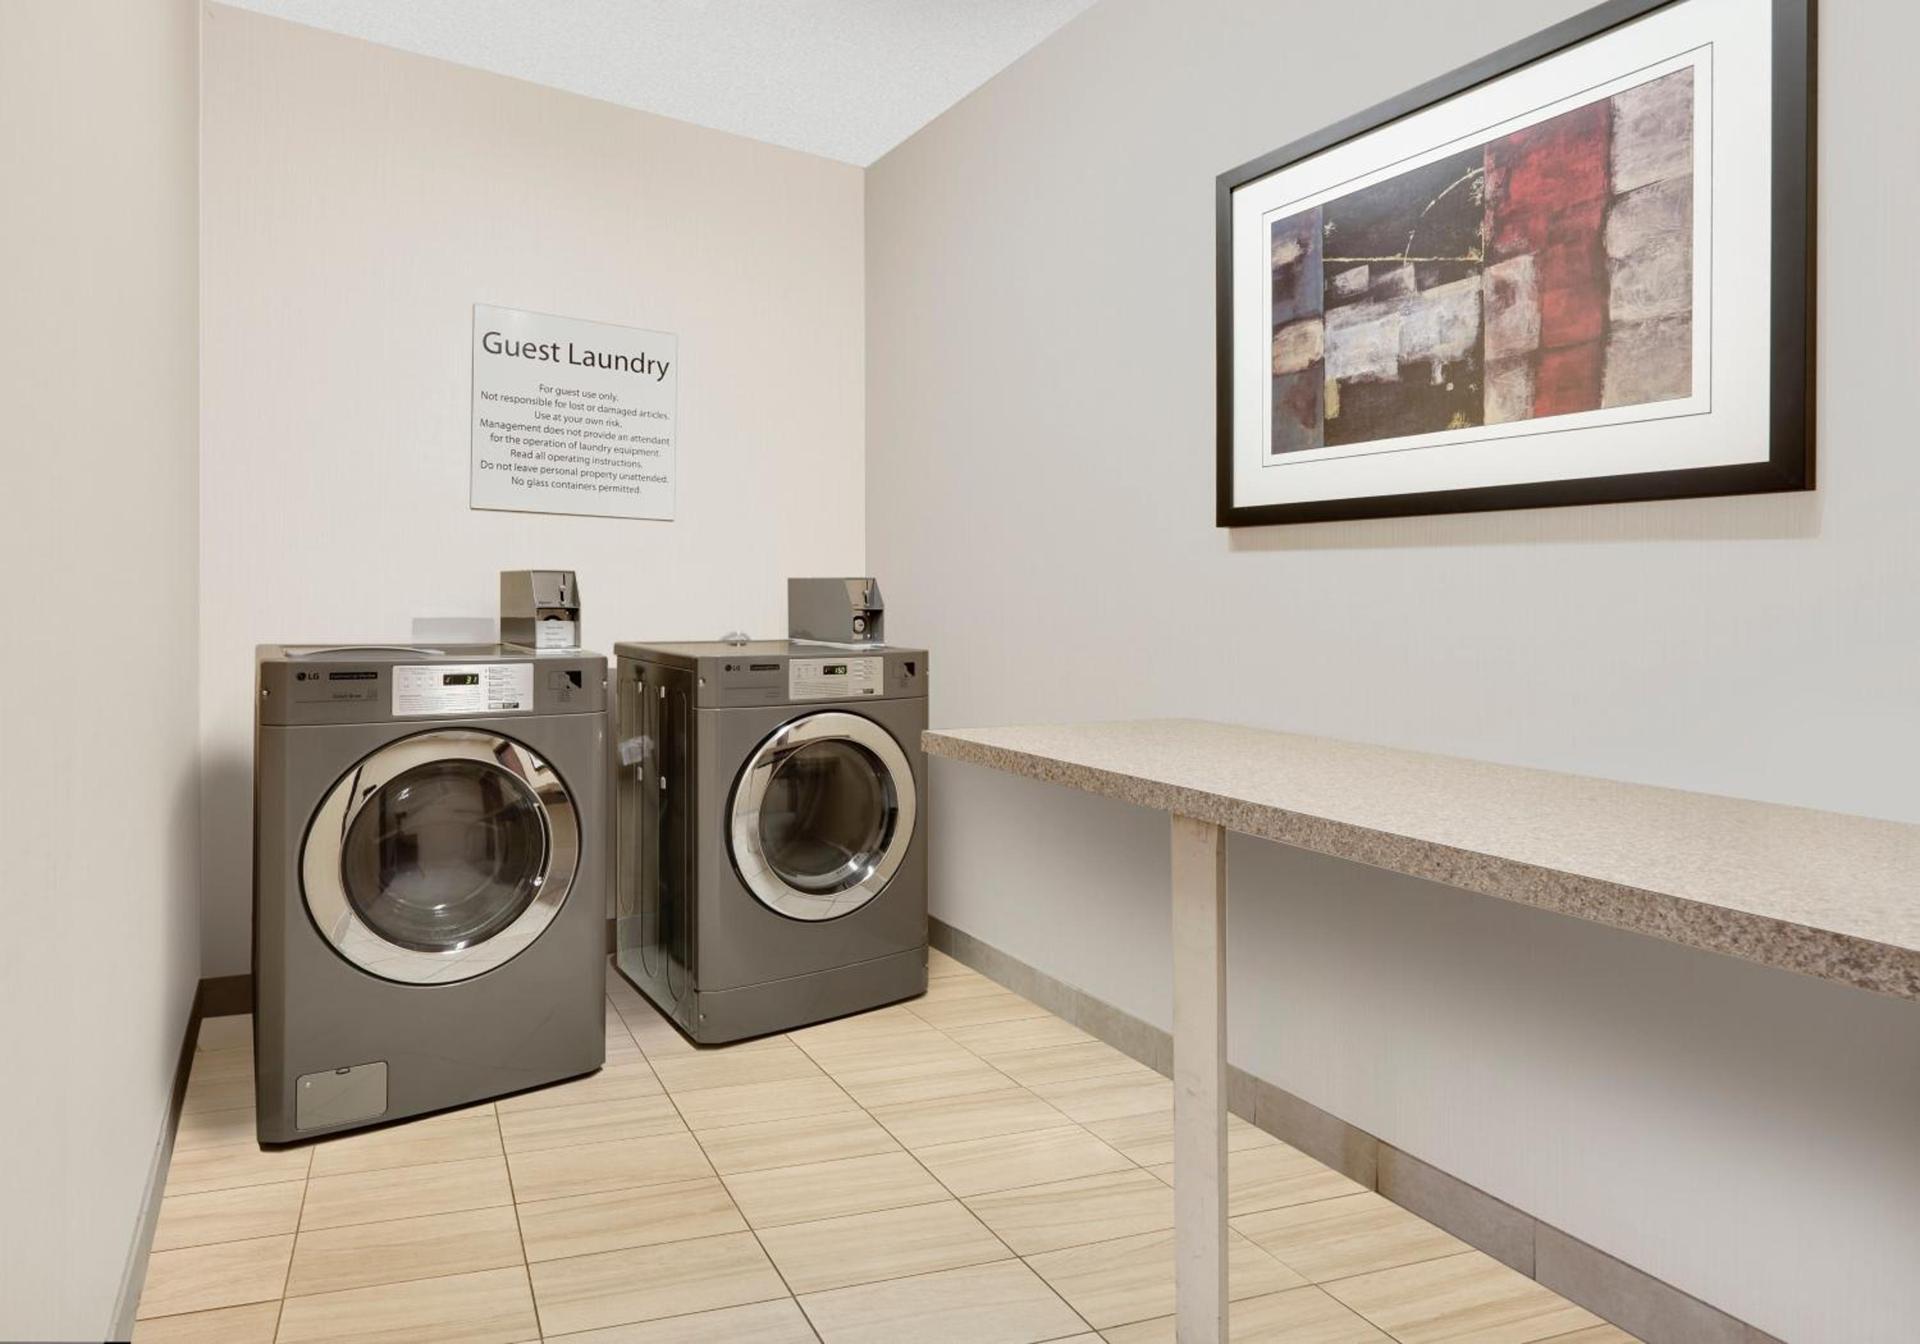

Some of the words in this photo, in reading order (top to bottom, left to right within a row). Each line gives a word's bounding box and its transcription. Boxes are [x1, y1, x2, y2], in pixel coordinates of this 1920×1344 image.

[482, 331, 560, 363] Guest
[568, 343, 670, 382] Laundry
[539, 384, 553, 393] For
[555, 387, 580, 397] guest
[582, 391, 597, 399] use
[599, 392, 619, 402] only.
[481, 391, 498, 401] Not
[500, 395, 552, 408] responsible
[555, 399, 567, 408] for
[569, 401, 584, 411] lost
[586, 404, 596, 412] or
[597, 405, 637, 417] damaged
[639, 409, 670, 420] articles.
[534, 411, 551, 420] Use
[553, 413, 562, 422] at
[563, 416, 583, 424] your
[585, 418, 604, 426] own
[606, 418, 623, 428] risk.
[480, 418, 541, 432] Management
[544, 425, 565, 435] does
[566, 428, 582, 437] not
[583, 430, 616, 440] provide
[618, 433, 628, 441] an
[630, 434, 670, 446] attendant
[490, 432, 503, 442] for
[505, 434, 521, 444] the
[522, 438, 566, 450] operation
[568, 440, 578, 449] of
[579, 442, 611, 453] laundry
[510, 449, 533, 459] Read
[535, 451, 546, 460] all
[547, 453, 590, 466] operating
[592, 457, 643, 469] instructions.
[480, 460, 494, 470] Do
[496, 462, 512, 472] not
[514, 463, 538, 473] leave
[540, 466, 578, 477] personal
[580, 469, 617, 481] property
[511, 476, 524, 486] No
[527, 478, 549, 488] glass
[551, 480, 597, 491] containers
